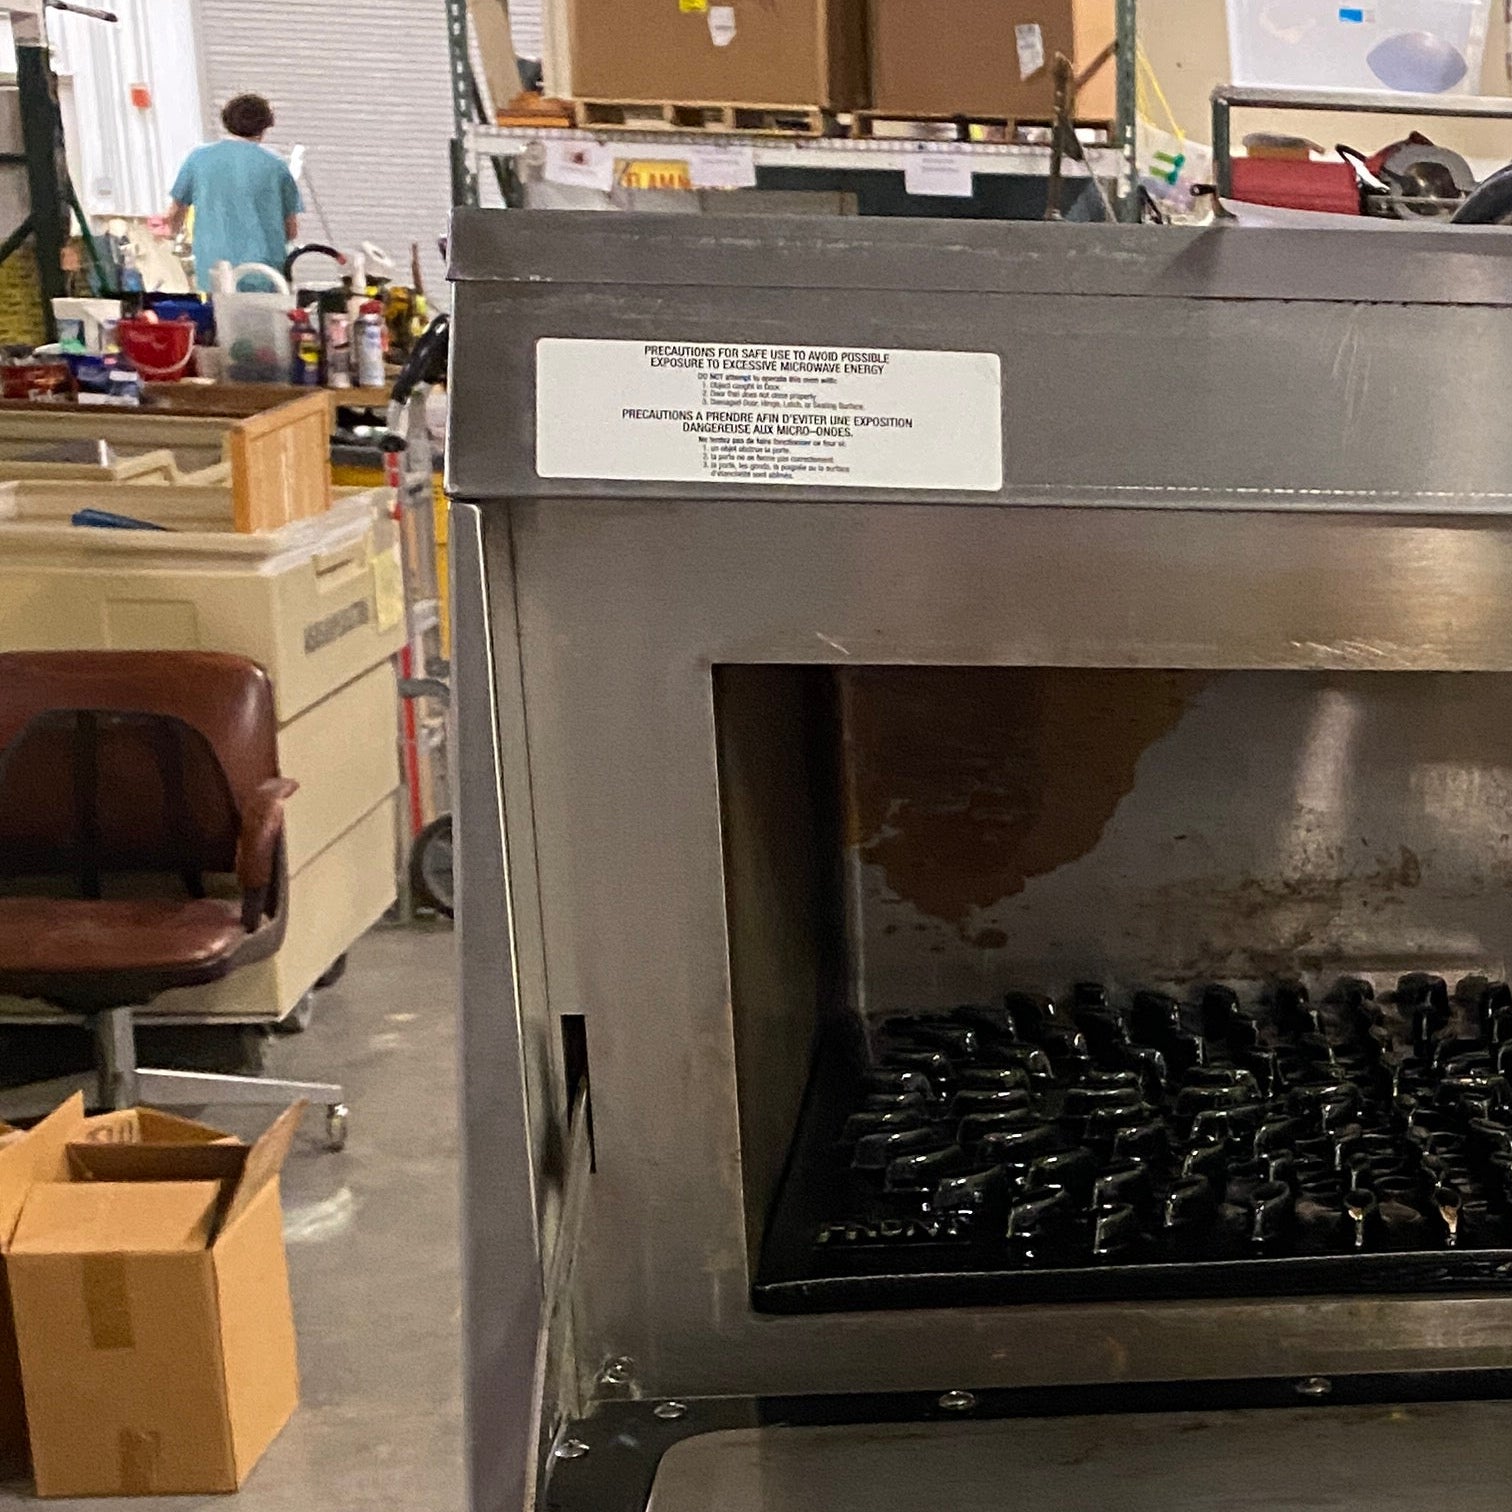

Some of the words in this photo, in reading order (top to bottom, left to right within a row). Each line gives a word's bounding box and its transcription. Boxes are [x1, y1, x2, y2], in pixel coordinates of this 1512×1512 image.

[645, 345, 715, 358] PRECAUTIONS
[718, 347, 739, 359] FOR
[742, 348, 767, 360] SAFE
[770, 349, 790, 360] USE
[793, 350, 806, 361] TO
[808, 351, 838, 362] AVOID
[841, 352, 890, 364] POSSIBLE
[650, 357, 704, 369] EXPOSURE
[707, 358, 720, 369] TO
[723, 359, 777, 371] EXCESSIVE
[780, 361, 841, 374] MICROWAVE
[844, 363, 885, 375] ENERGY
[622, 409, 693, 421] PRECAUTIONS
[695, 411, 703, 421] A
[706, 412, 754, 423] PRENDRE
[756, 413, 779, 424] AFIN
[782, 414, 827, 425] D'EVITER
[830, 415, 850, 426] UNE
[854, 416, 913, 428] EXPOSITION
[682, 422, 750, 435] DANGEREUSE
[752, 424, 773, 434] AUX
